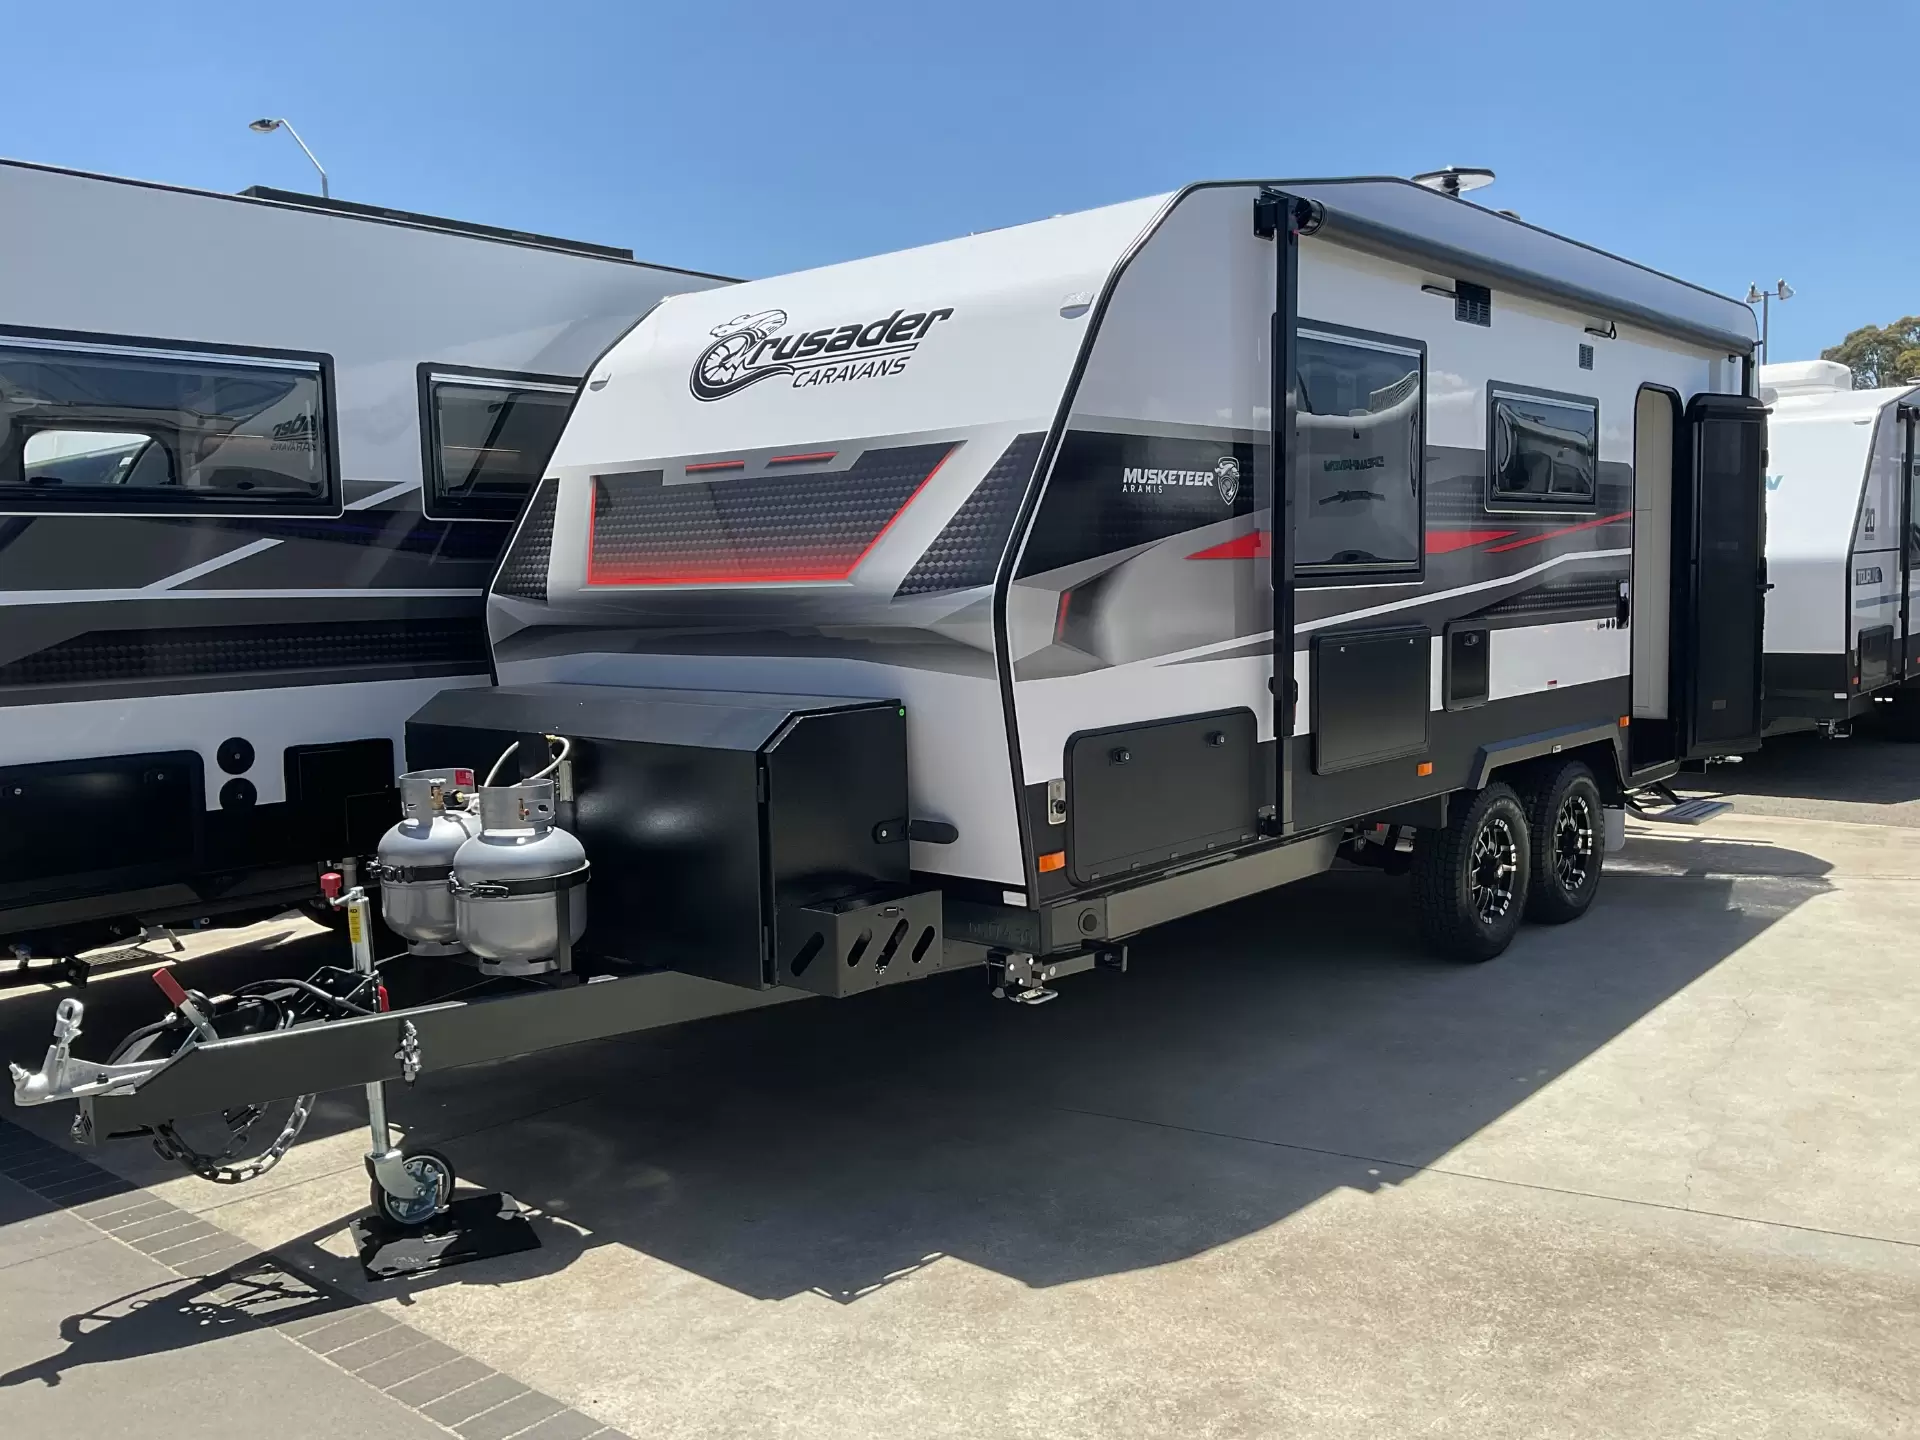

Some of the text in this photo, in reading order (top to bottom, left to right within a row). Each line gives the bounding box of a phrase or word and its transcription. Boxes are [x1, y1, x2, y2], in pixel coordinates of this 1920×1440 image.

[792, 356, 911, 389] CARAVANS
[1123, 467, 1214, 487] MUSKETEER
[1122, 484, 1163, 494] ARAMIS
